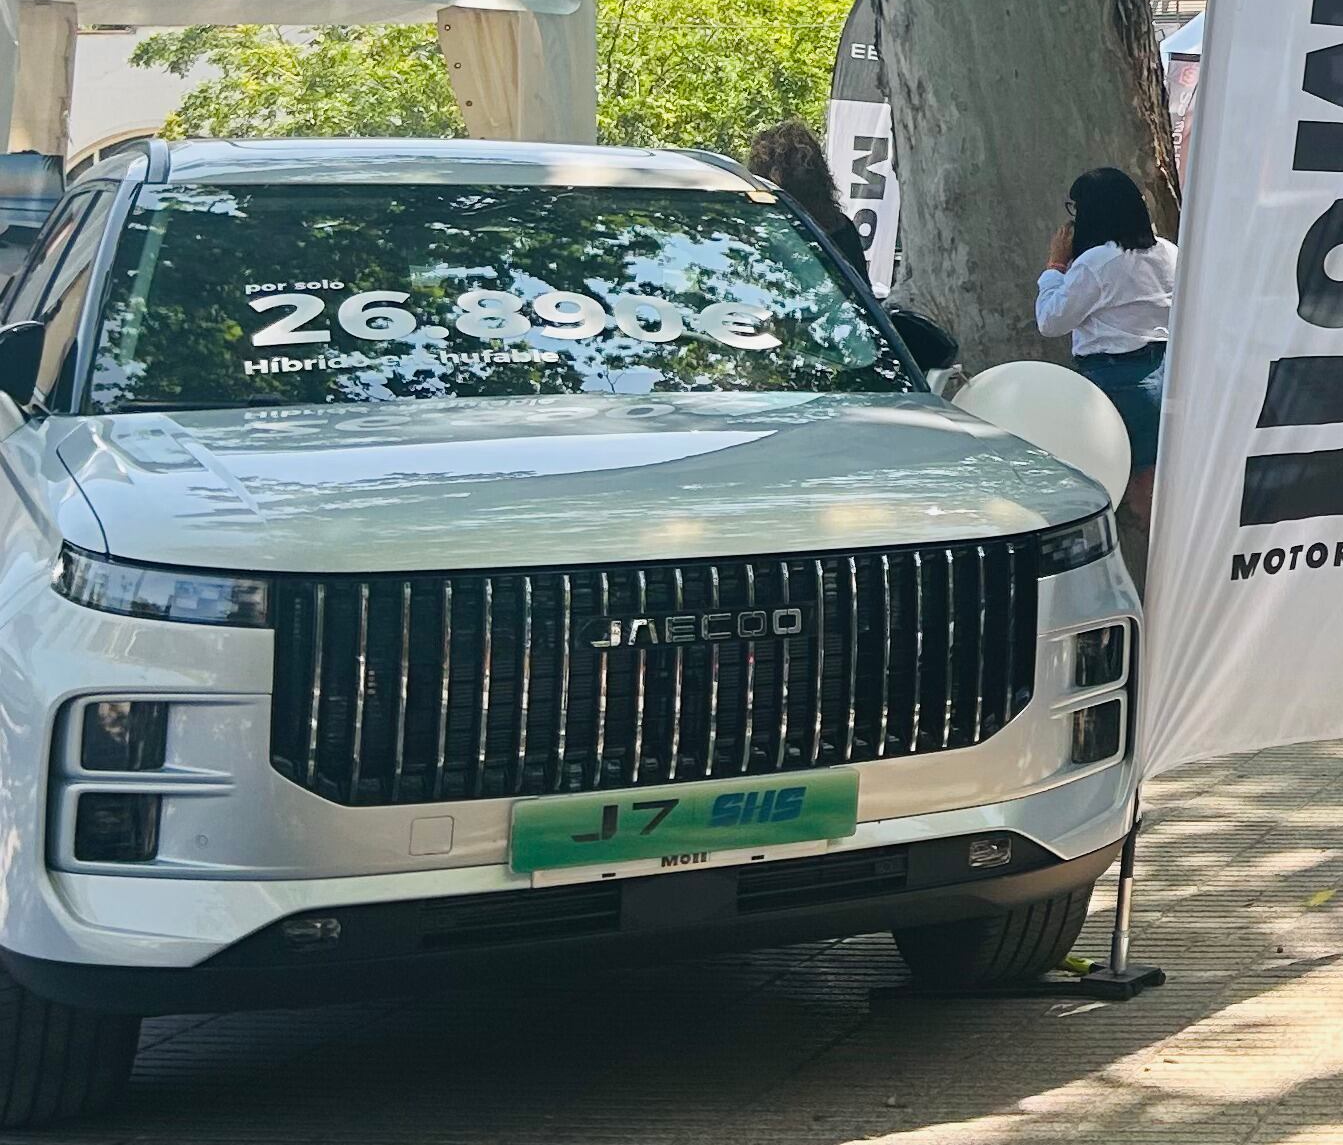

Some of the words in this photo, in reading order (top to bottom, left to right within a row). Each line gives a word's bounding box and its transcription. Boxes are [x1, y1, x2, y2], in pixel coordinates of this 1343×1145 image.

[245, 282, 287, 295] por
[294, 279, 346, 292] solo
[591, 608, 802, 648] JAECOO
[708, 786, 807, 828] SHS
[661, 851, 708, 867] Moll
